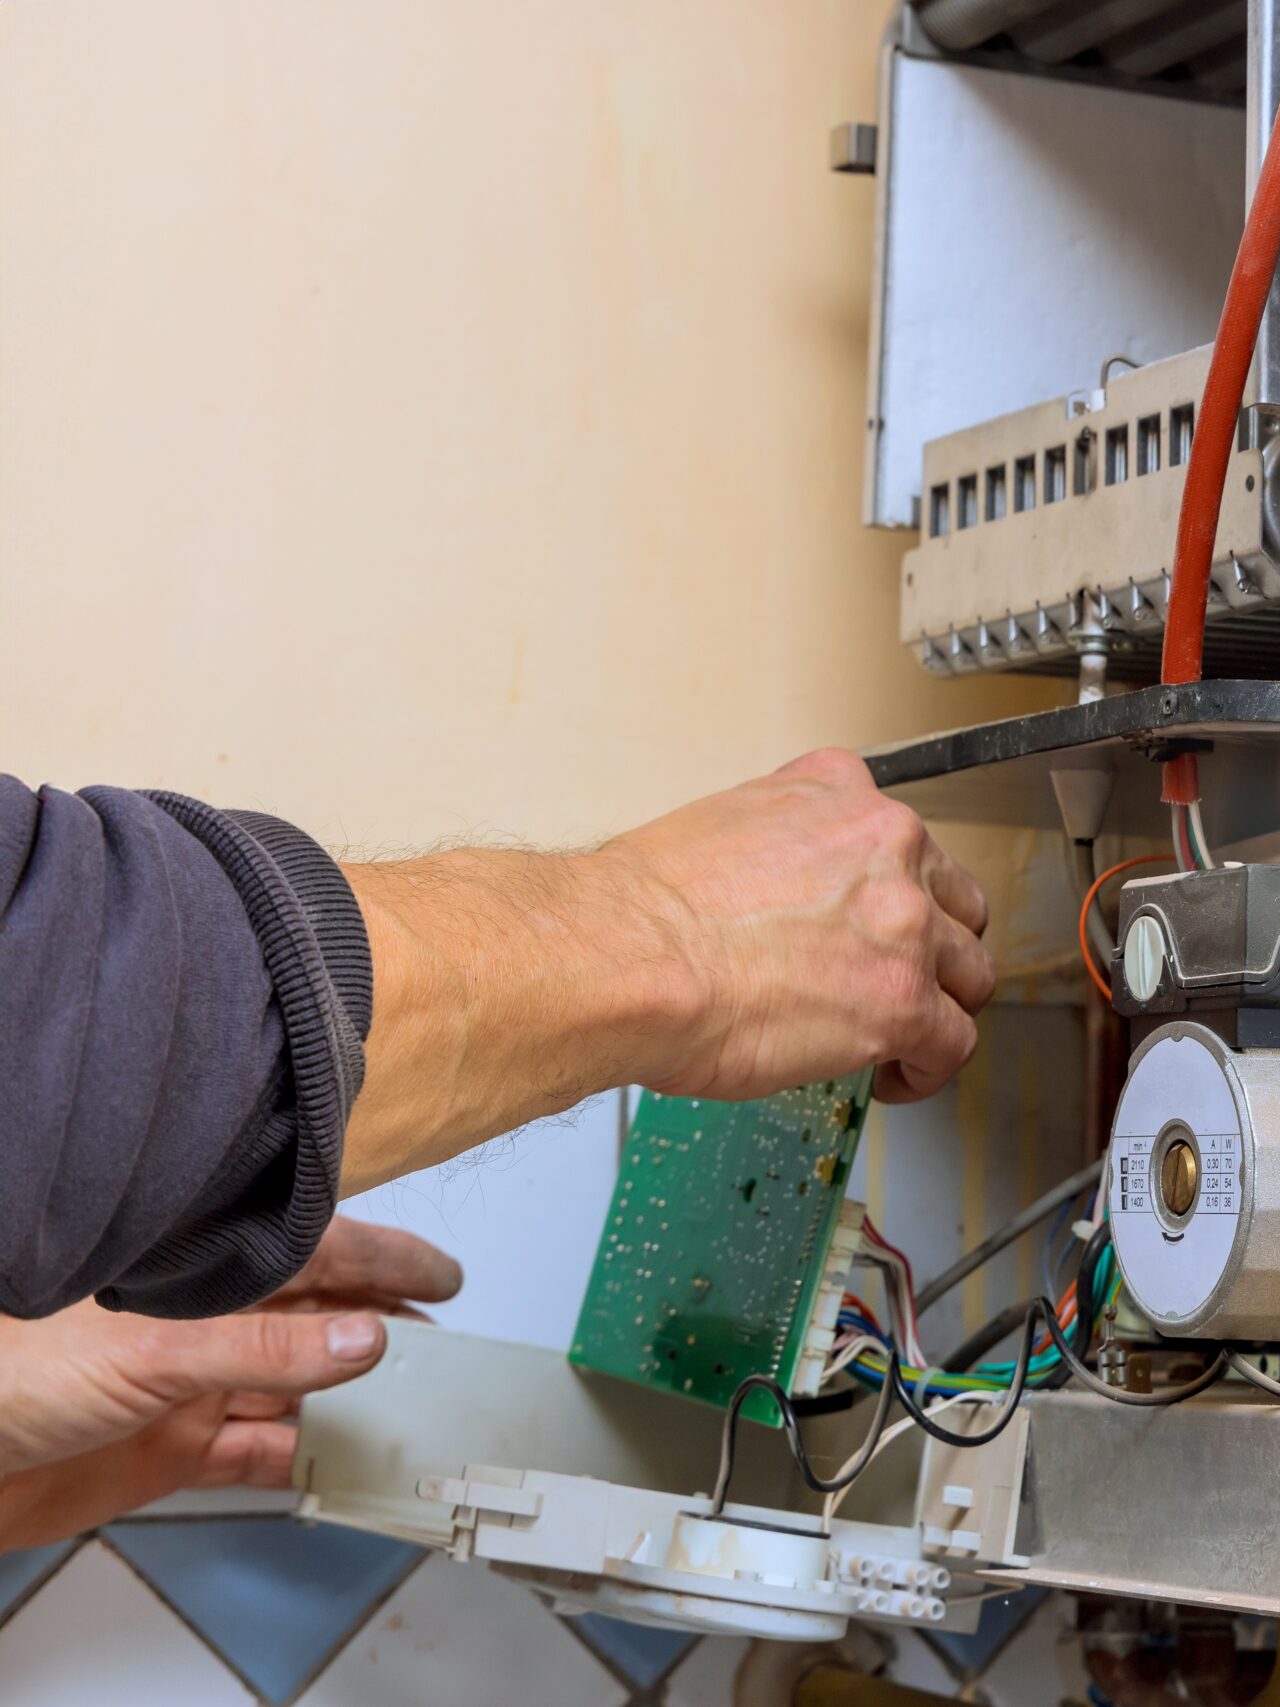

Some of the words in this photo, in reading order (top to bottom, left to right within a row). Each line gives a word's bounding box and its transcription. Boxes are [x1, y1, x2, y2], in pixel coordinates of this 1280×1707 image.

[1211, 1140, 1216, 1150] A
[1225, 1139, 1232, 1150] W
[1131, 1159, 1145, 1170] 2110
[1206, 1158, 1219, 1170] 0,30
[1225, 1158, 1233, 1169] 70
[1131, 1178, 1144, 1189] 1670
[1224, 1177, 1232, 1189] 54
[1130, 1197, 1144, 1208] 1400
[1223, 1196, 1232, 1208] 36
